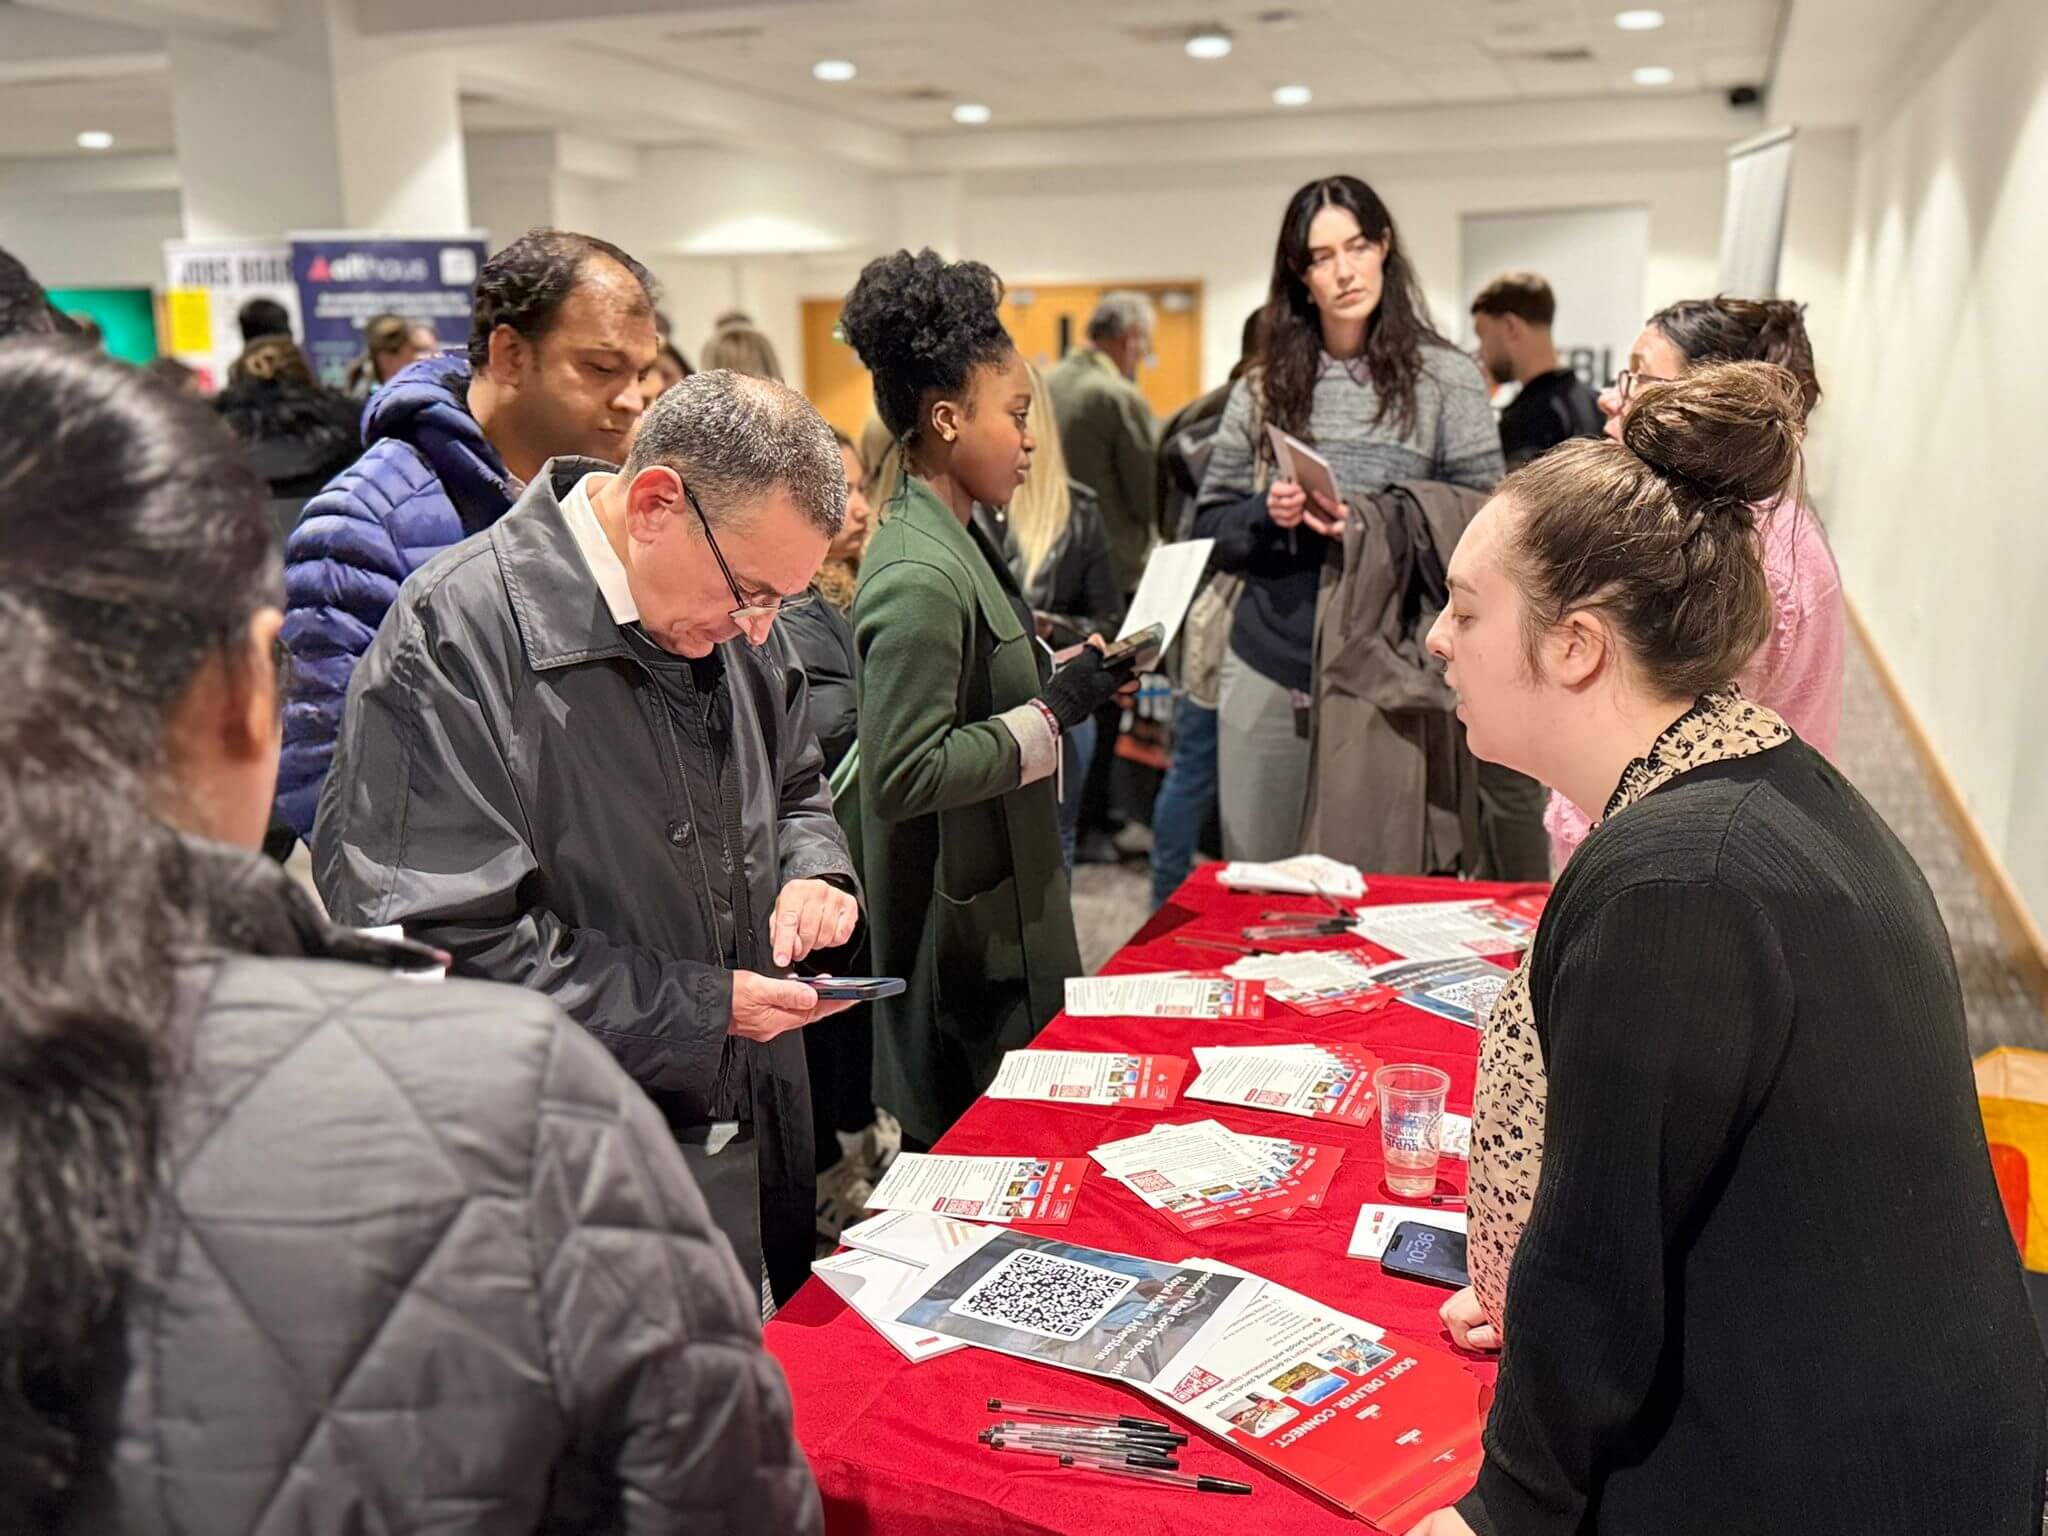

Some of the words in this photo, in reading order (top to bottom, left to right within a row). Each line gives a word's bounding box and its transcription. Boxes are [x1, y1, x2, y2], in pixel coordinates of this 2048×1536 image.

[1407, 1232, 1435, 1264] 10:36
[1162, 1276, 1187, 1297] Royal
[1184, 1272, 1214, 1297] easonal
[1146, 1292, 1168, 1314] Mail
[1168, 1298, 1190, 1317] Mail
[1135, 1311, 1149, 1320] in
[1147, 1315, 1175, 1340] Sorter
[1094, 1318, 1142, 1361] Atherstone
[1124, 1338, 1152, 1360] Roles
[1380, 1356, 1418, 1380] SORT.
[1333, 1378, 1385, 1410] DELIVER.
[1270, 1410, 1336, 1448] CONNECT.
